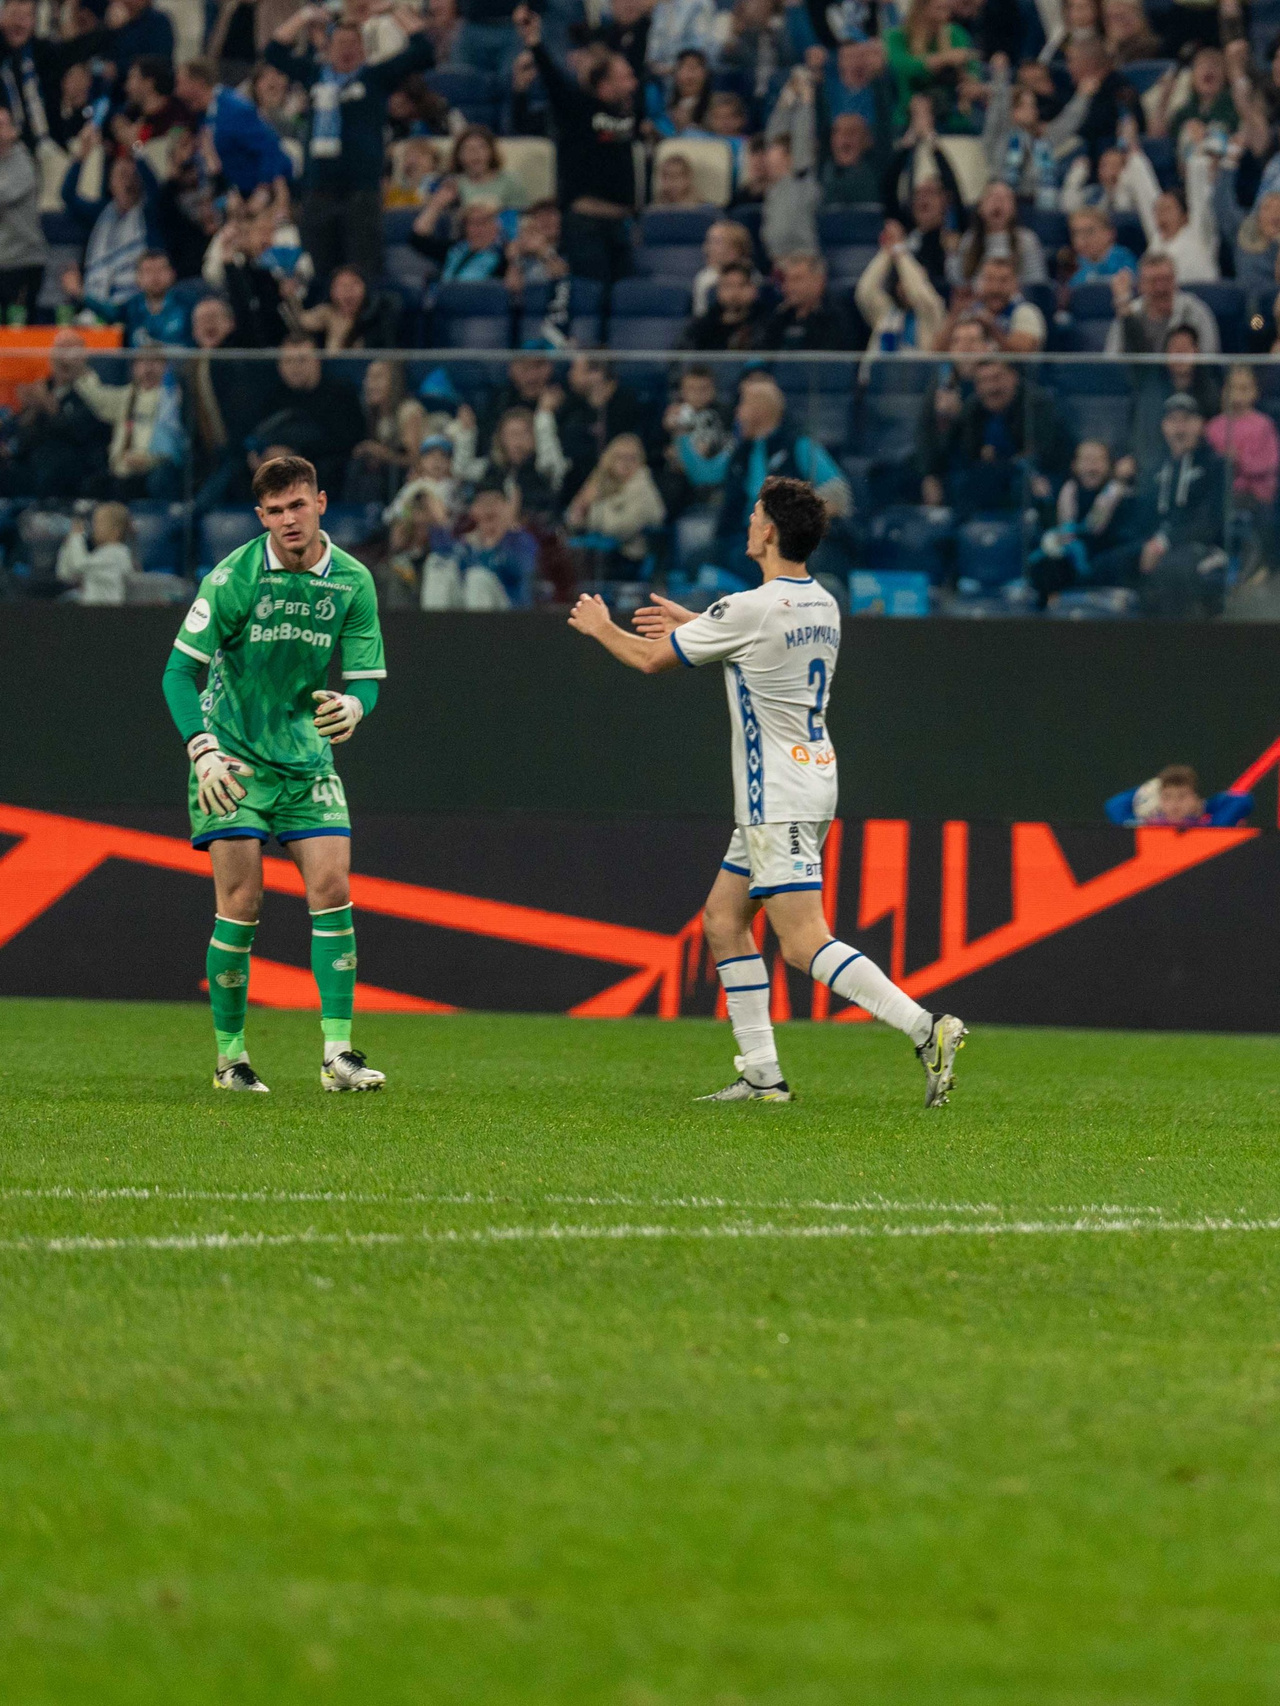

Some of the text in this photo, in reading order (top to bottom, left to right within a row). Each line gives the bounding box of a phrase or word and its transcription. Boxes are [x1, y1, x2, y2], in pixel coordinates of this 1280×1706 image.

[309, 579, 352, 592] CHANGAN
[284, 601, 311, 617] ВТБ
[249, 622, 332, 648] BetBoom
[807, 658, 826, 742] 2
